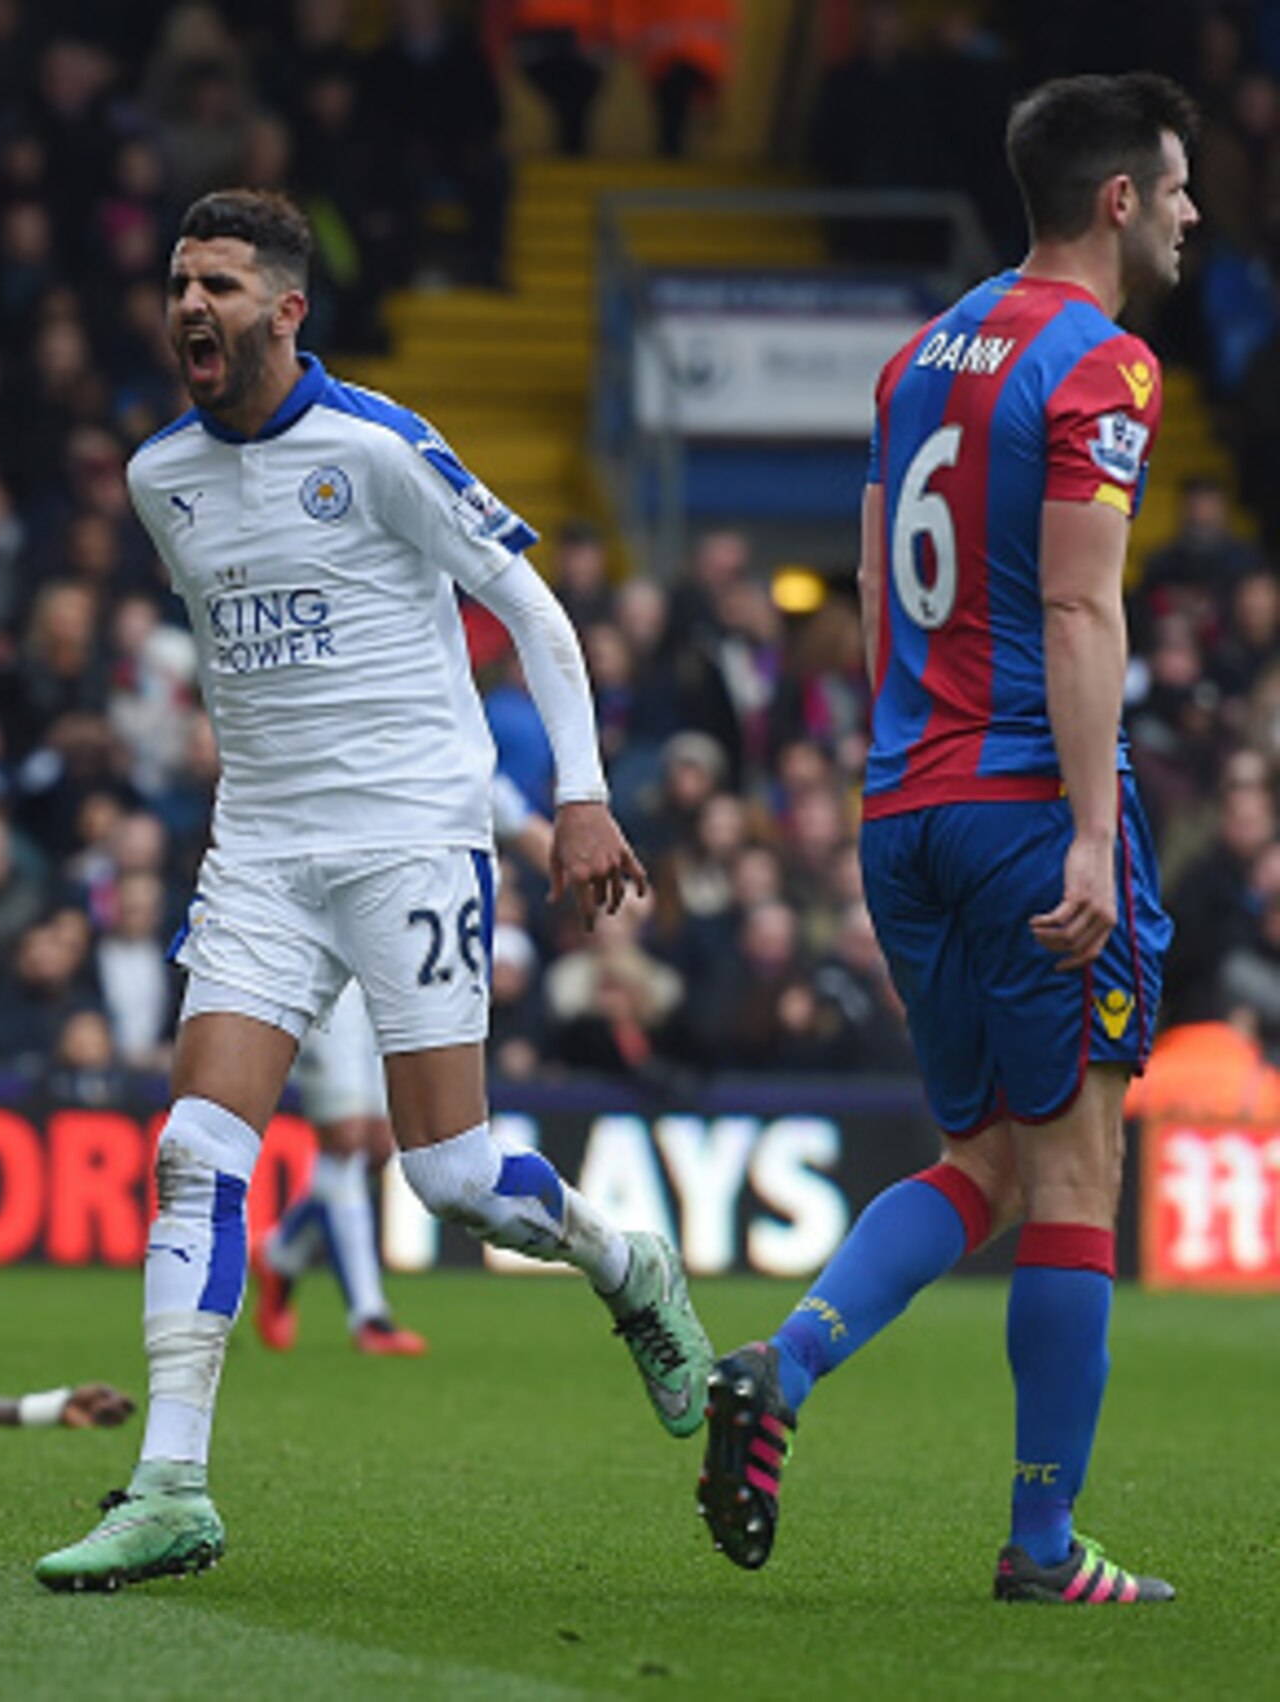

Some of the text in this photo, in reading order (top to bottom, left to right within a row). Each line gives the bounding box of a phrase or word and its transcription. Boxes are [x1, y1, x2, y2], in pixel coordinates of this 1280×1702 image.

[916, 331, 1016, 375] DANN
[892, 425, 962, 630] 6
[207, 589, 329, 638] KING
[408, 898, 484, 993] 26
